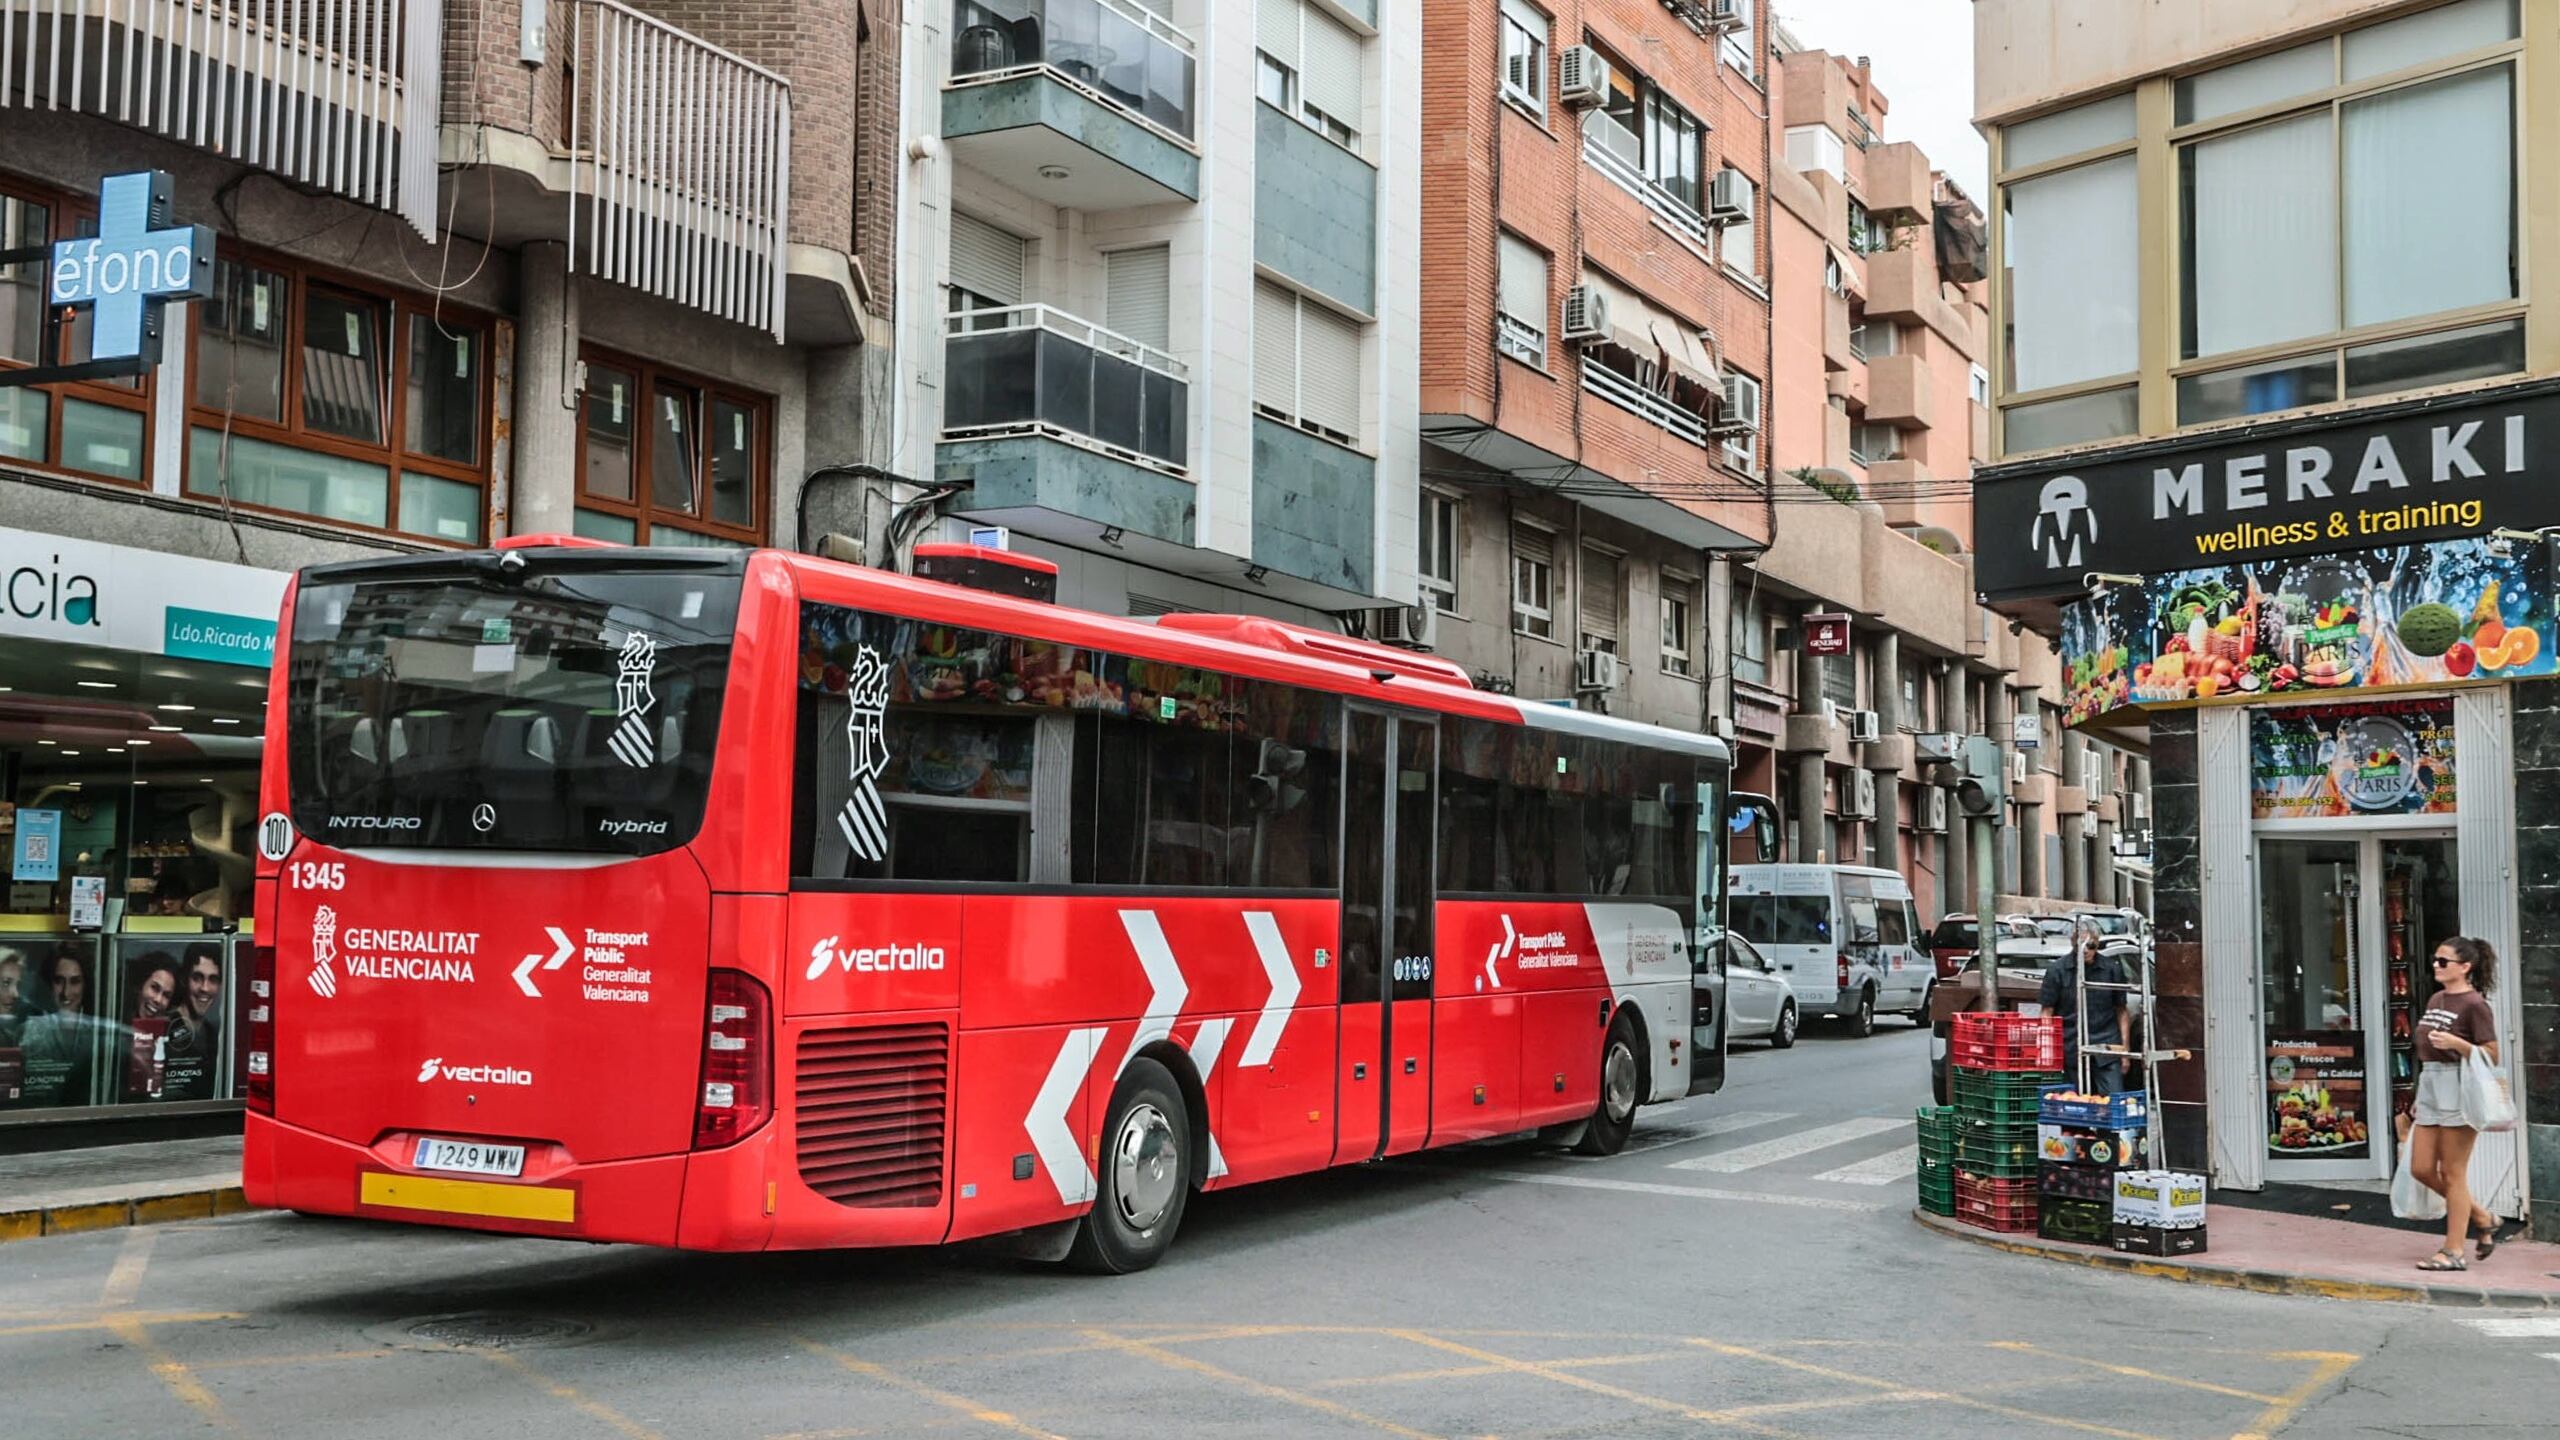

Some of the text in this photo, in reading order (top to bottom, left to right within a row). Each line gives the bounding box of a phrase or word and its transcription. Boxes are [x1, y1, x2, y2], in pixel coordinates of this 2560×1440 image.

[2153, 414, 2525, 520] MERAKI
[2195, 500, 2483, 555] wellness & training
[0, 554, 101, 627] cia
[2297, 639, 2361, 663] PARIS
[2354, 777, 2402, 793] PARIS
[328, 815, 422, 830] INTOURO
[599, 818, 668, 835] hybrid
[265, 818, 288, 855] 100
[290, 861, 346, 891] 1345
[344, 928, 480, 956] GENERALITAT
[584, 928, 649, 948] Transport
[1518, 933, 1547, 951] Transport
[584, 945, 626, 964] Públic
[838, 942, 945, 972] vectalia
[1518, 951, 1578, 969] Generalitat Valenciana
[344, 954, 475, 983] VALENCIANA
[583, 965, 652, 985] Generalitat
[582, 983, 650, 1003] Valenciana
[2272, 1040, 2318, 1049] Productos
[2300, 1055, 2335, 1063] Frescos
[441, 1063, 532, 1086] vectalia
[2317, 1069, 2364, 1078] de Calidad
[434, 1144, 479, 1168] 1249
